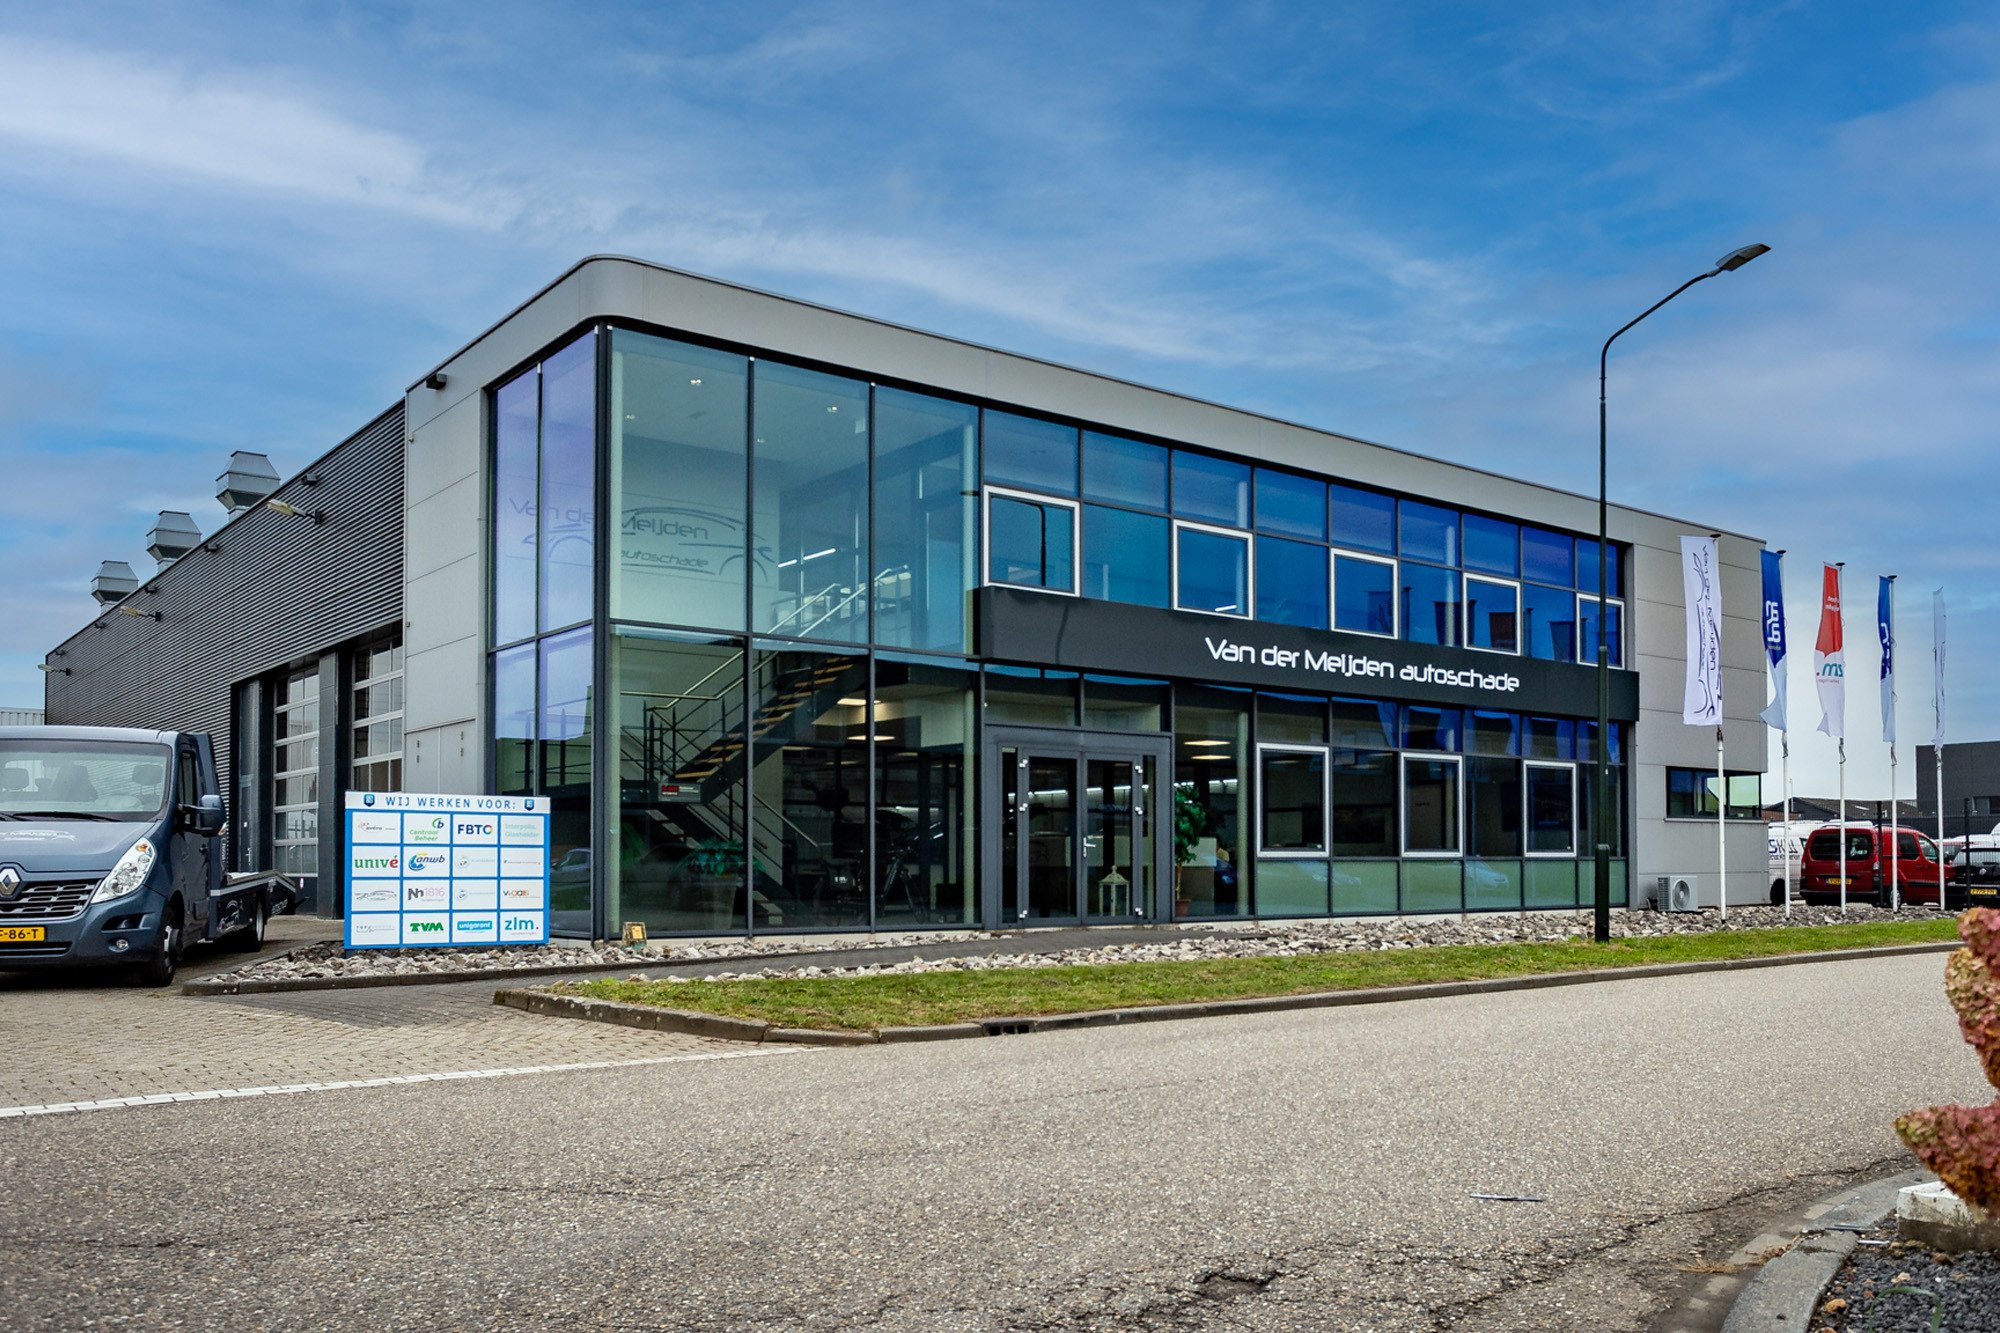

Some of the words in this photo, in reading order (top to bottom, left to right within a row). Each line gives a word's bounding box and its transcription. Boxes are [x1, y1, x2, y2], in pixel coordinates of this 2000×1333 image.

[1205, 637, 1255, 664] Van
[1260, 645, 1300, 669] der
[1305, 650, 1394, 679] Meijden
[1400, 664, 1520, 692] autoschade
[385, 796, 410, 806] WIJ
[417, 797, 470, 808] WERKEN
[477, 799, 517, 810] VOOR:
[457, 823, 493, 835] FBTO
[354, 855, 398, 869] univé
[409, 921, 444, 932] TVM
